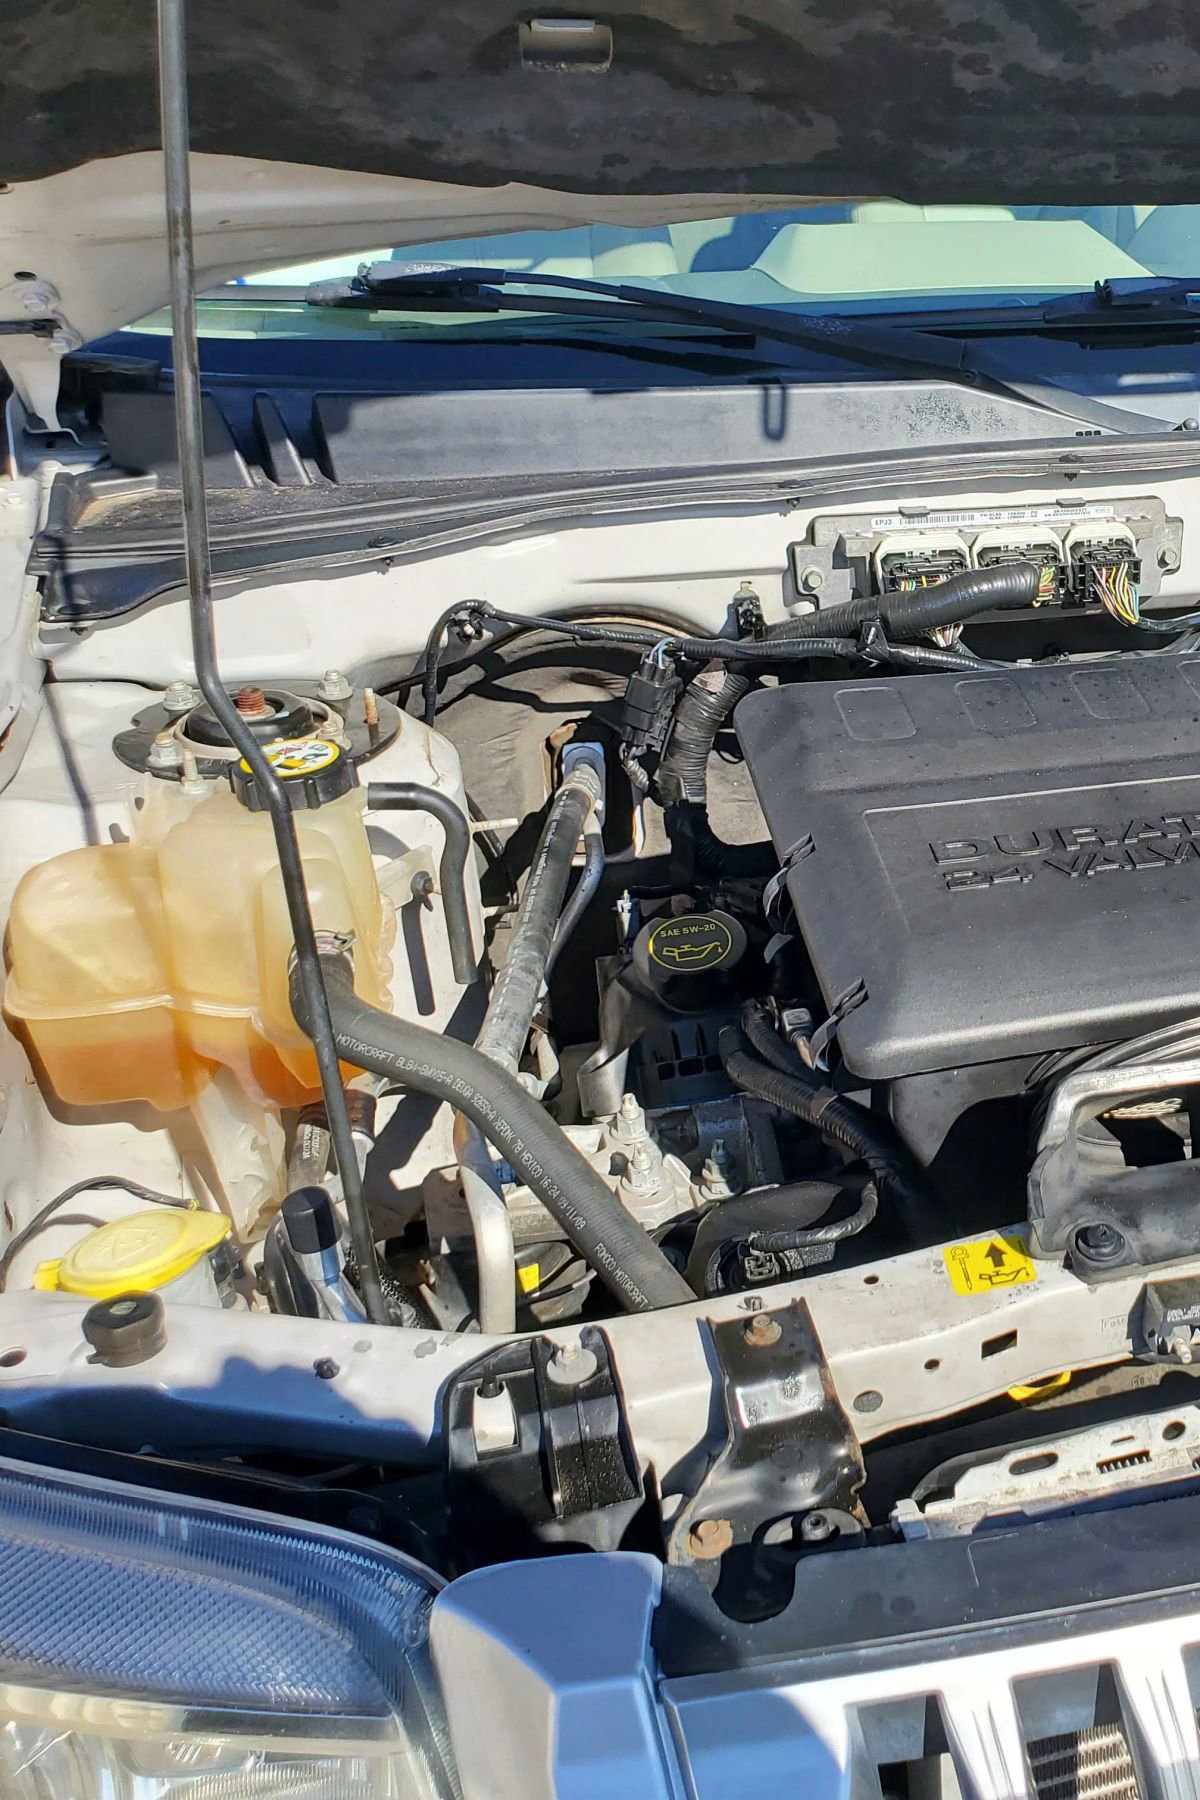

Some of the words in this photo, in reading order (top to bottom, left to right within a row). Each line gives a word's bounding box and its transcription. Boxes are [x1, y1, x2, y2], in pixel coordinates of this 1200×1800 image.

[875, 518, 893, 526] EPJ3
[943, 866, 1035, 892] 24
[660, 928, 681, 938] SAE
[682, 923, 716, 935] 5W-20
[336, 1033, 396, 1063] MOTORCRAFT
[520, 1149, 543, 1179] MEXICO
[540, 1176, 559, 1200] 16:24
[594, 1243, 617, 1270] FOMOCO
[614, 1267, 649, 1310] MOTORCRAFT
